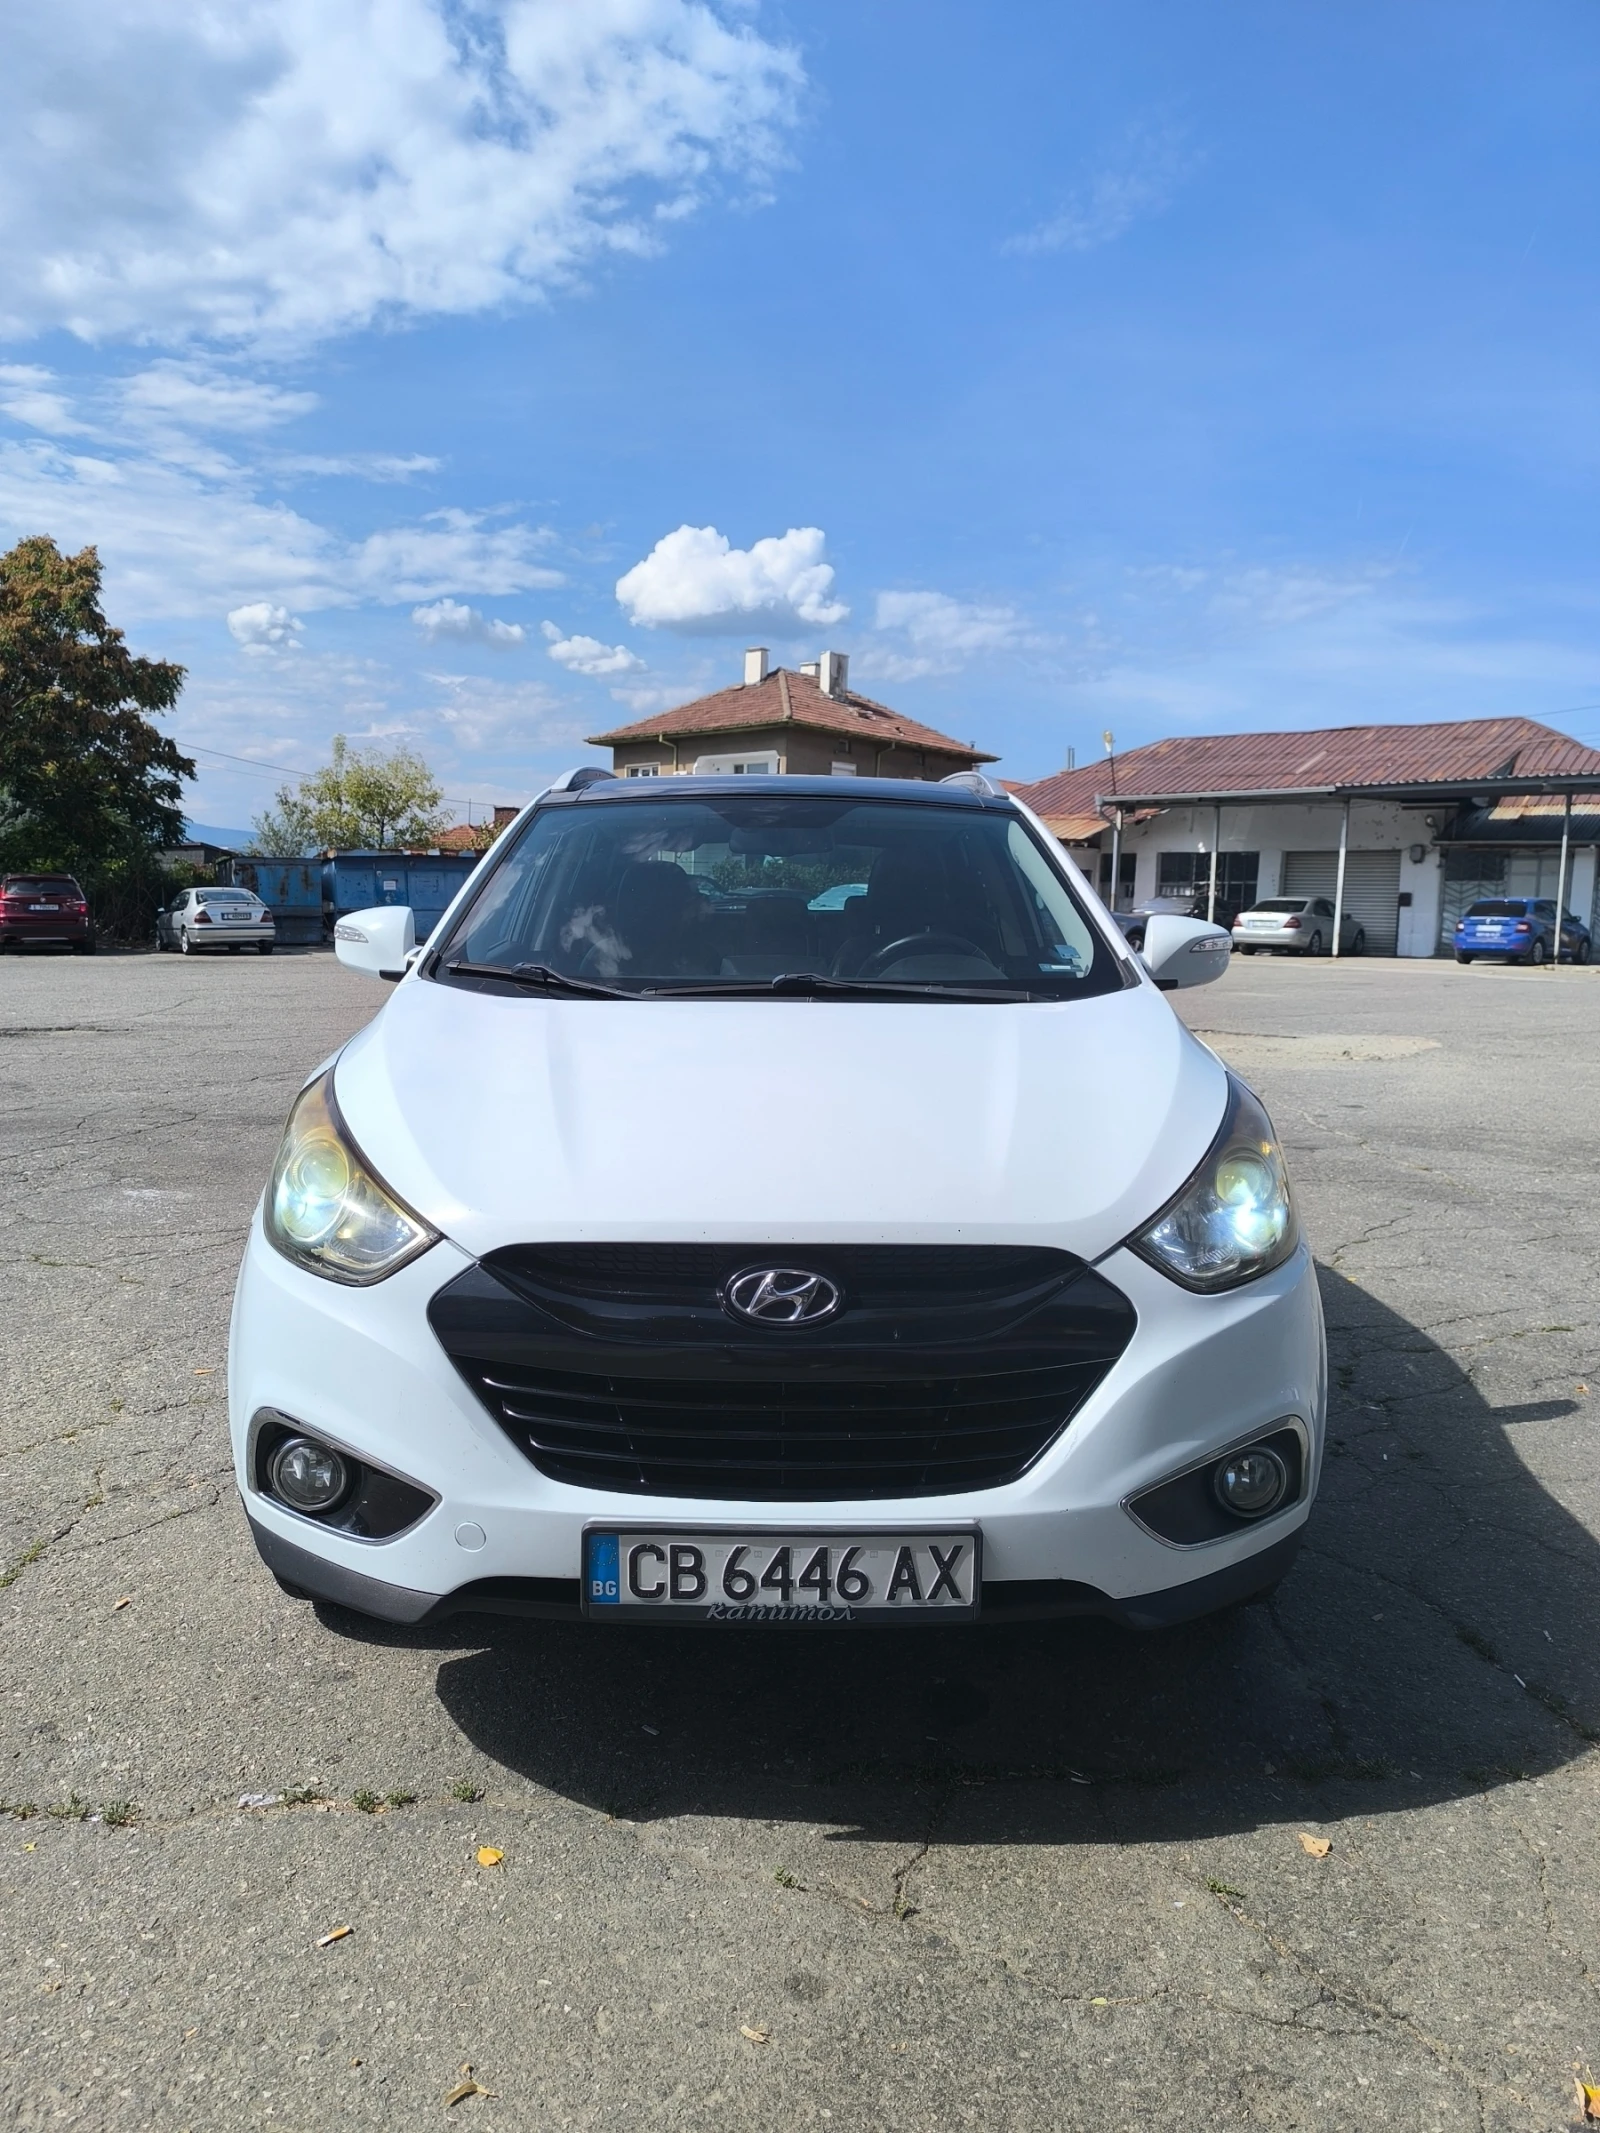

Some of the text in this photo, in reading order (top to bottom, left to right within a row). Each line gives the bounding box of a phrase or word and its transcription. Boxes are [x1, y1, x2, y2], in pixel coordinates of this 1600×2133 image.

[592, 1580, 617, 1596] BG
[628, 1543, 964, 1601] CB 6446 AX
